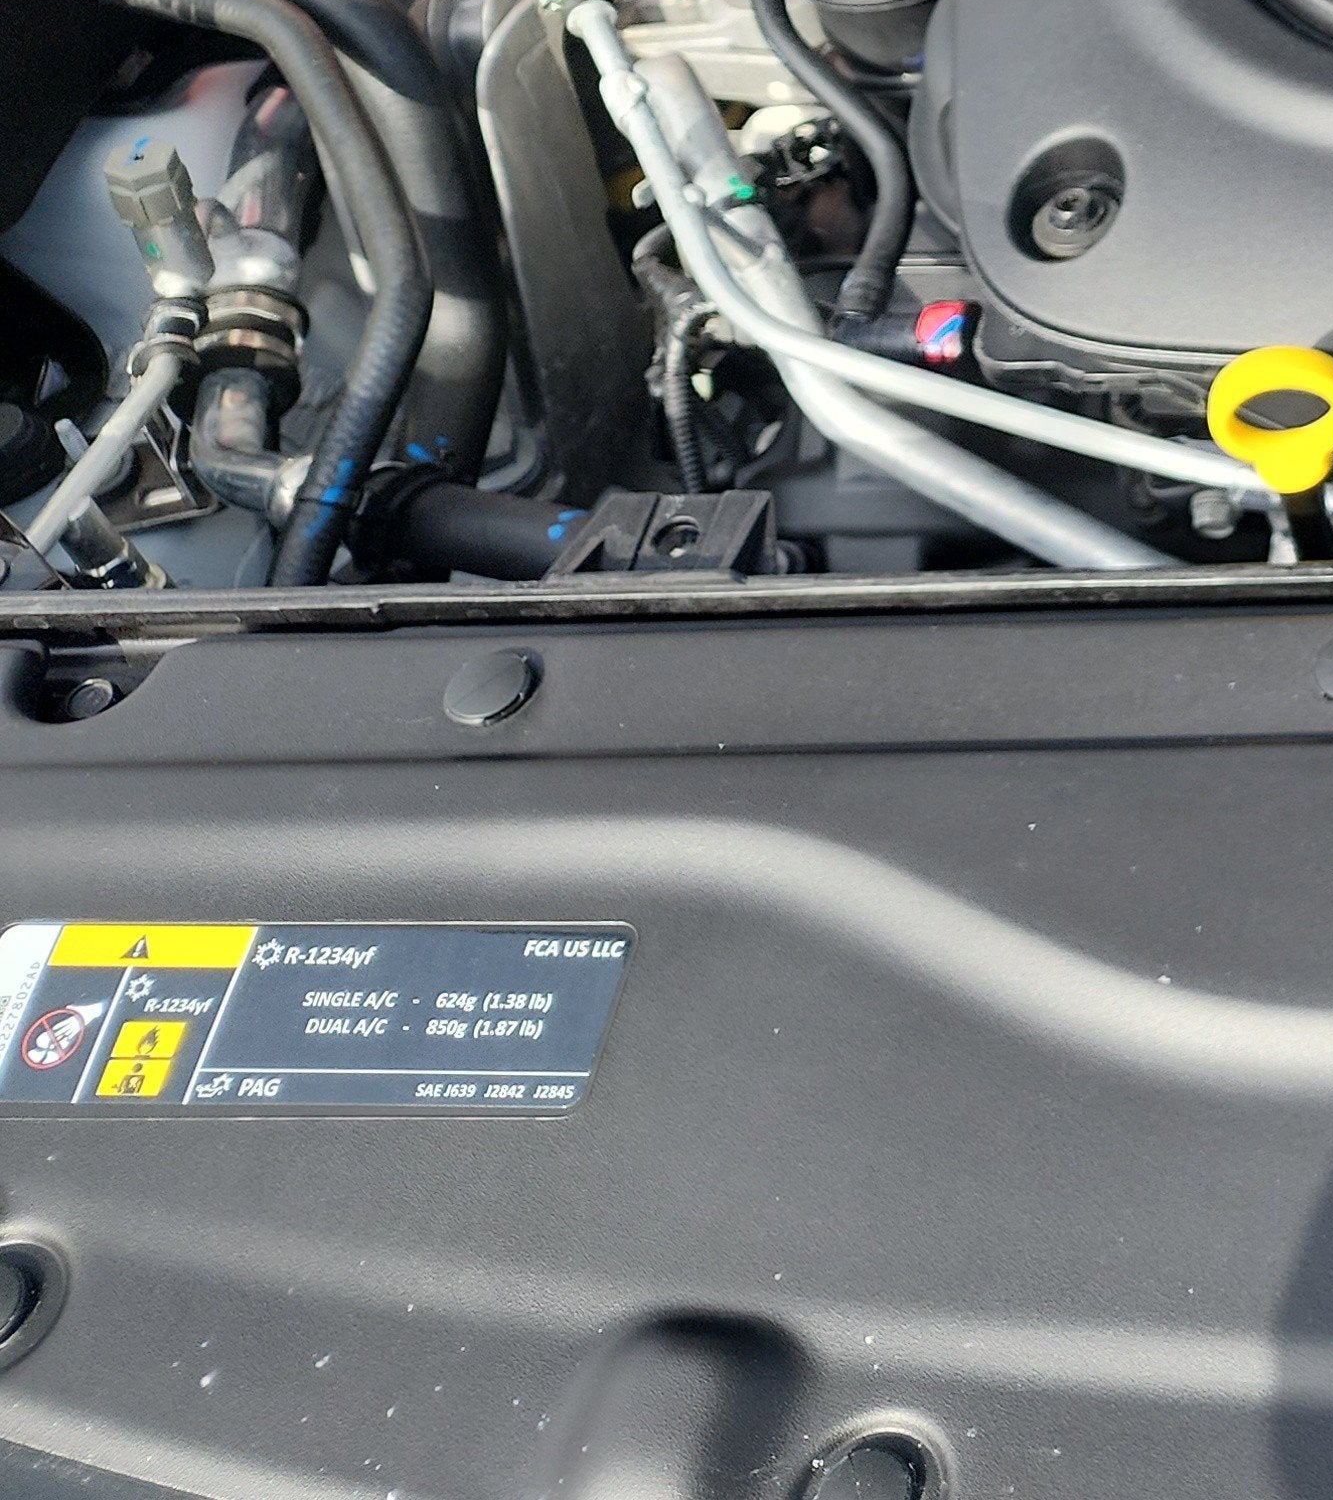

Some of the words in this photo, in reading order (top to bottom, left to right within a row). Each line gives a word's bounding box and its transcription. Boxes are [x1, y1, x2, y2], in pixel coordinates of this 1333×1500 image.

[284, 947, 377, 969] R-1234yf
[523, 939, 560, 958] FCA
[563, 940, 590, 958] US
[591, 940, 626, 958] LLC
[143, 997, 212, 1016] R-1234yf
[302, 991, 363, 1008] SINGLE
[363, 991, 399, 1010] A/C
[435, 992, 477, 1012] 624g
[482, 992, 528, 1012] (1.38
[528, 992, 553, 1013] lb)
[304, 1018, 351, 1034] DUAL
[352, 1017, 388, 1037] A/C
[425, 1019, 468, 1038] 850g
[473, 1019, 519, 1039] (1.87
[519, 1019, 544, 1040] lb)
[237, 1078, 282, 1097] PAG
[415, 1083, 443, 1098] SAE
[443, 1084, 477, 1098] J639
[483, 1084, 526, 1099] J2842
[532, 1085, 575, 1099] J2845
